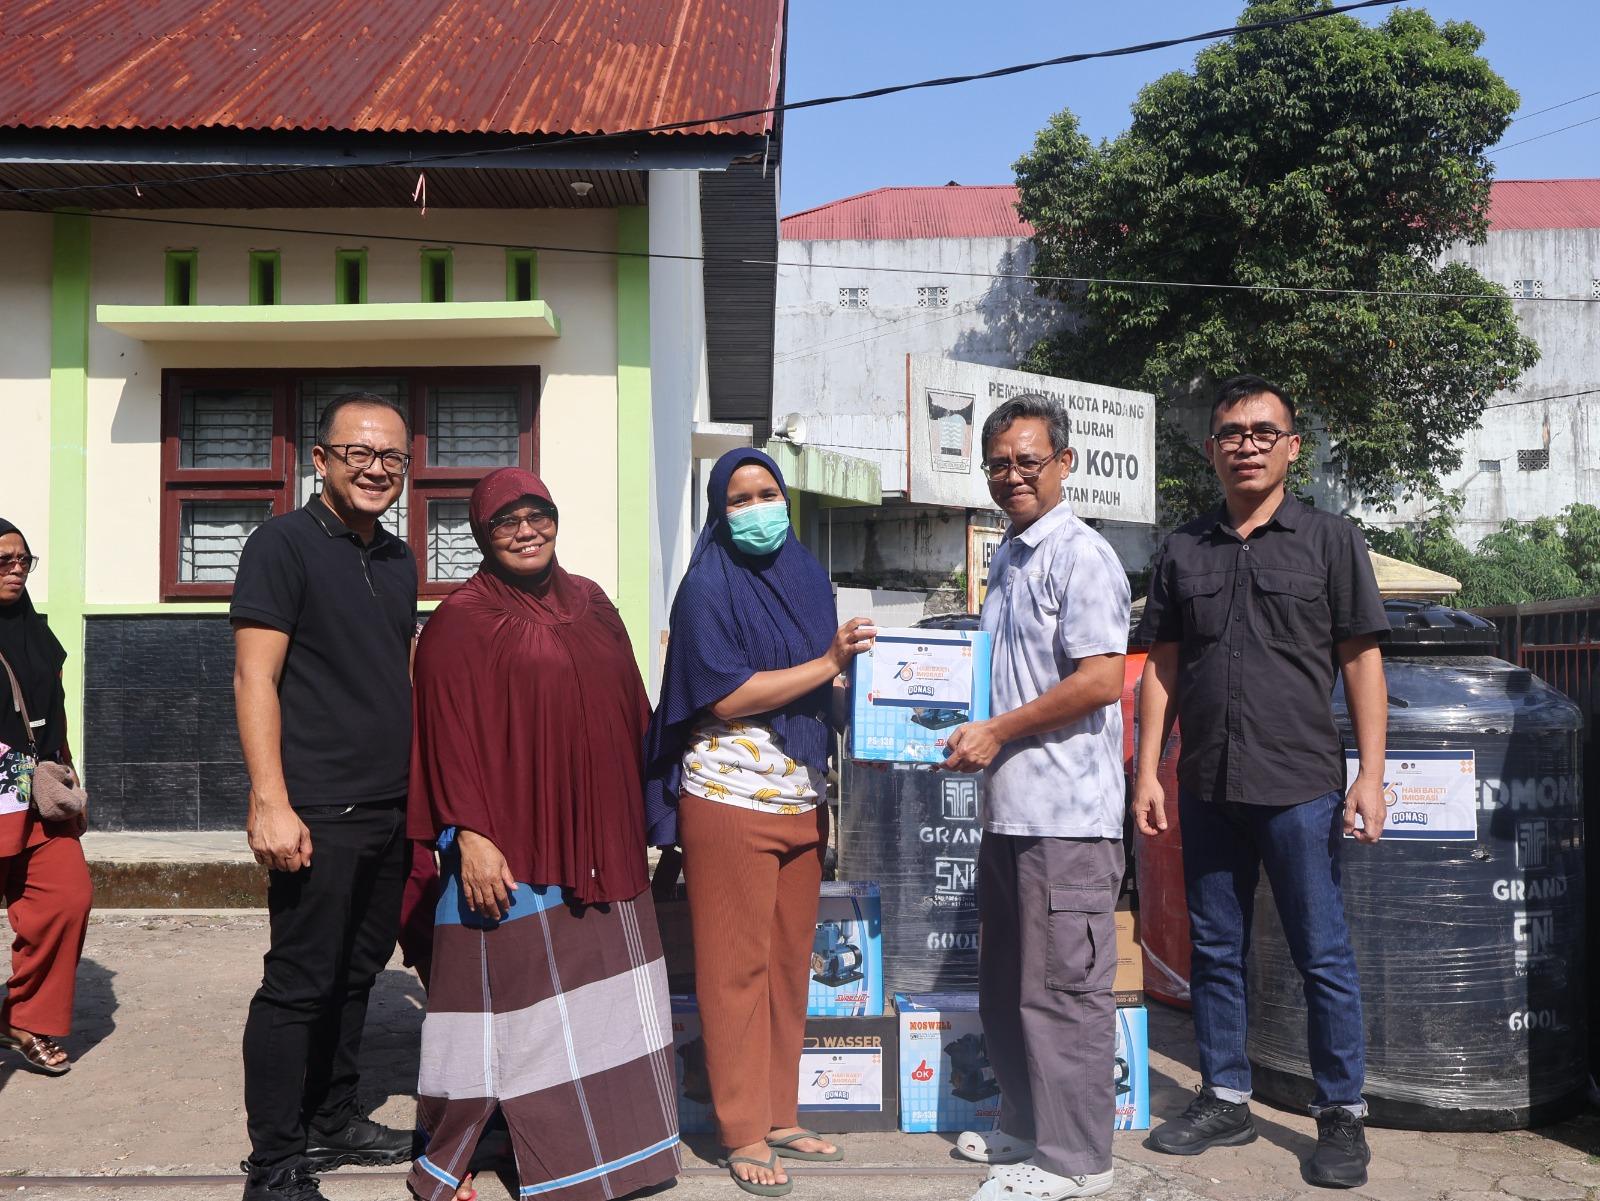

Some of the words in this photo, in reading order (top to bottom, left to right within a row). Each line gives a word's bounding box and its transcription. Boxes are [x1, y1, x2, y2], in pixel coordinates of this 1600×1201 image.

[1069, 395, 1099, 413] KOTA
[1076, 419, 1114, 439] LURAH
[1086, 448, 1139, 481] KOTO
[1092, 489, 1121, 506] PAUH
[908, 685, 935, 696] DONASI
[1392, 811, 1427, 825] DONASI
[919, 826, 983, 843] GRAN
[1492, 878, 1568, 901] GRAND
[909, 1021, 952, 1030] MOSWELL
[822, 1036, 881, 1048] WASSER
[916, 1070, 929, 1078] OK
